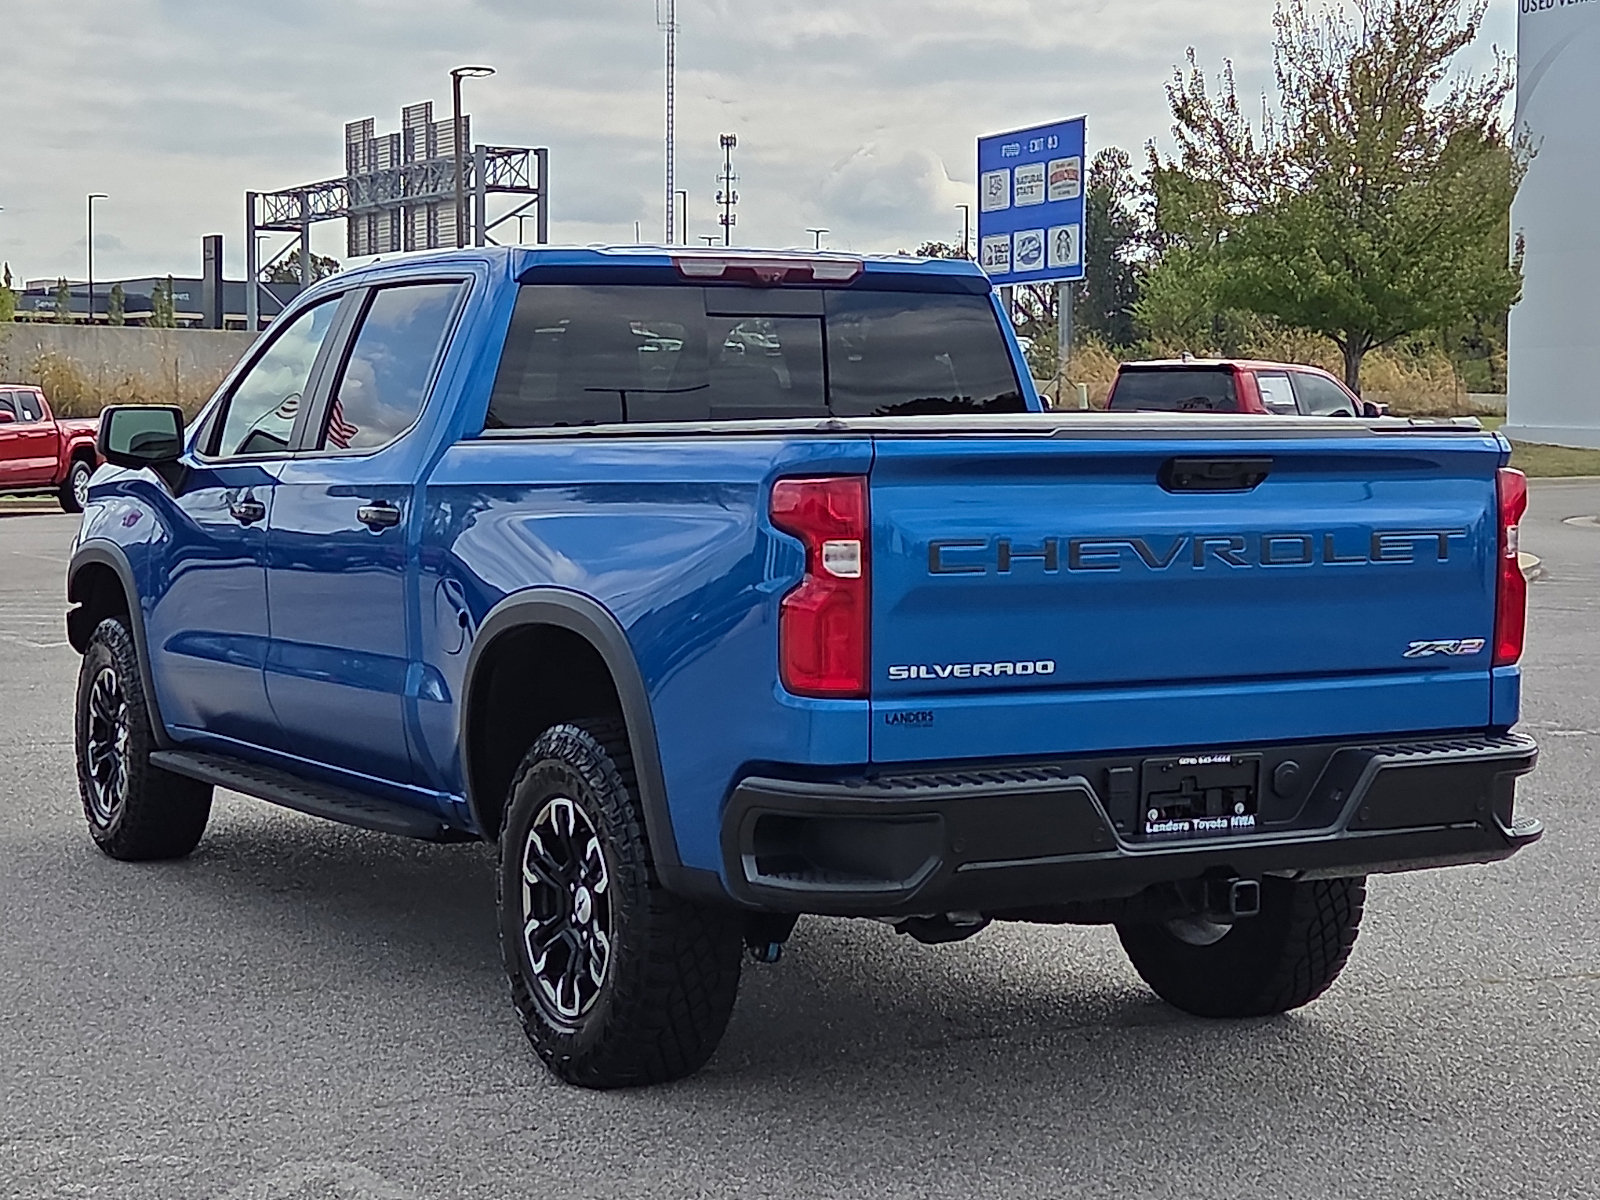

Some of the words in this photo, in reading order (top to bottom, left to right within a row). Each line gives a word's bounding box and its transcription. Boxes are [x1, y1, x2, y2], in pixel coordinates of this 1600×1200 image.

[1521, 0, 1554, 13] USED
[1016, 173, 1043, 185] NATURAL
[993, 243, 1009, 254] TACO
[994, 254, 1009, 265] BELL
[928, 527, 1467, 576] CHEVROLET
[1402, 638, 1486, 658] ZR2
[888, 660, 1055, 680] SILVERADO
[885, 711, 934, 725] LANDERS
[1145, 821, 1190, 834] Landers
[1191, 818, 1229, 832] Toyota
